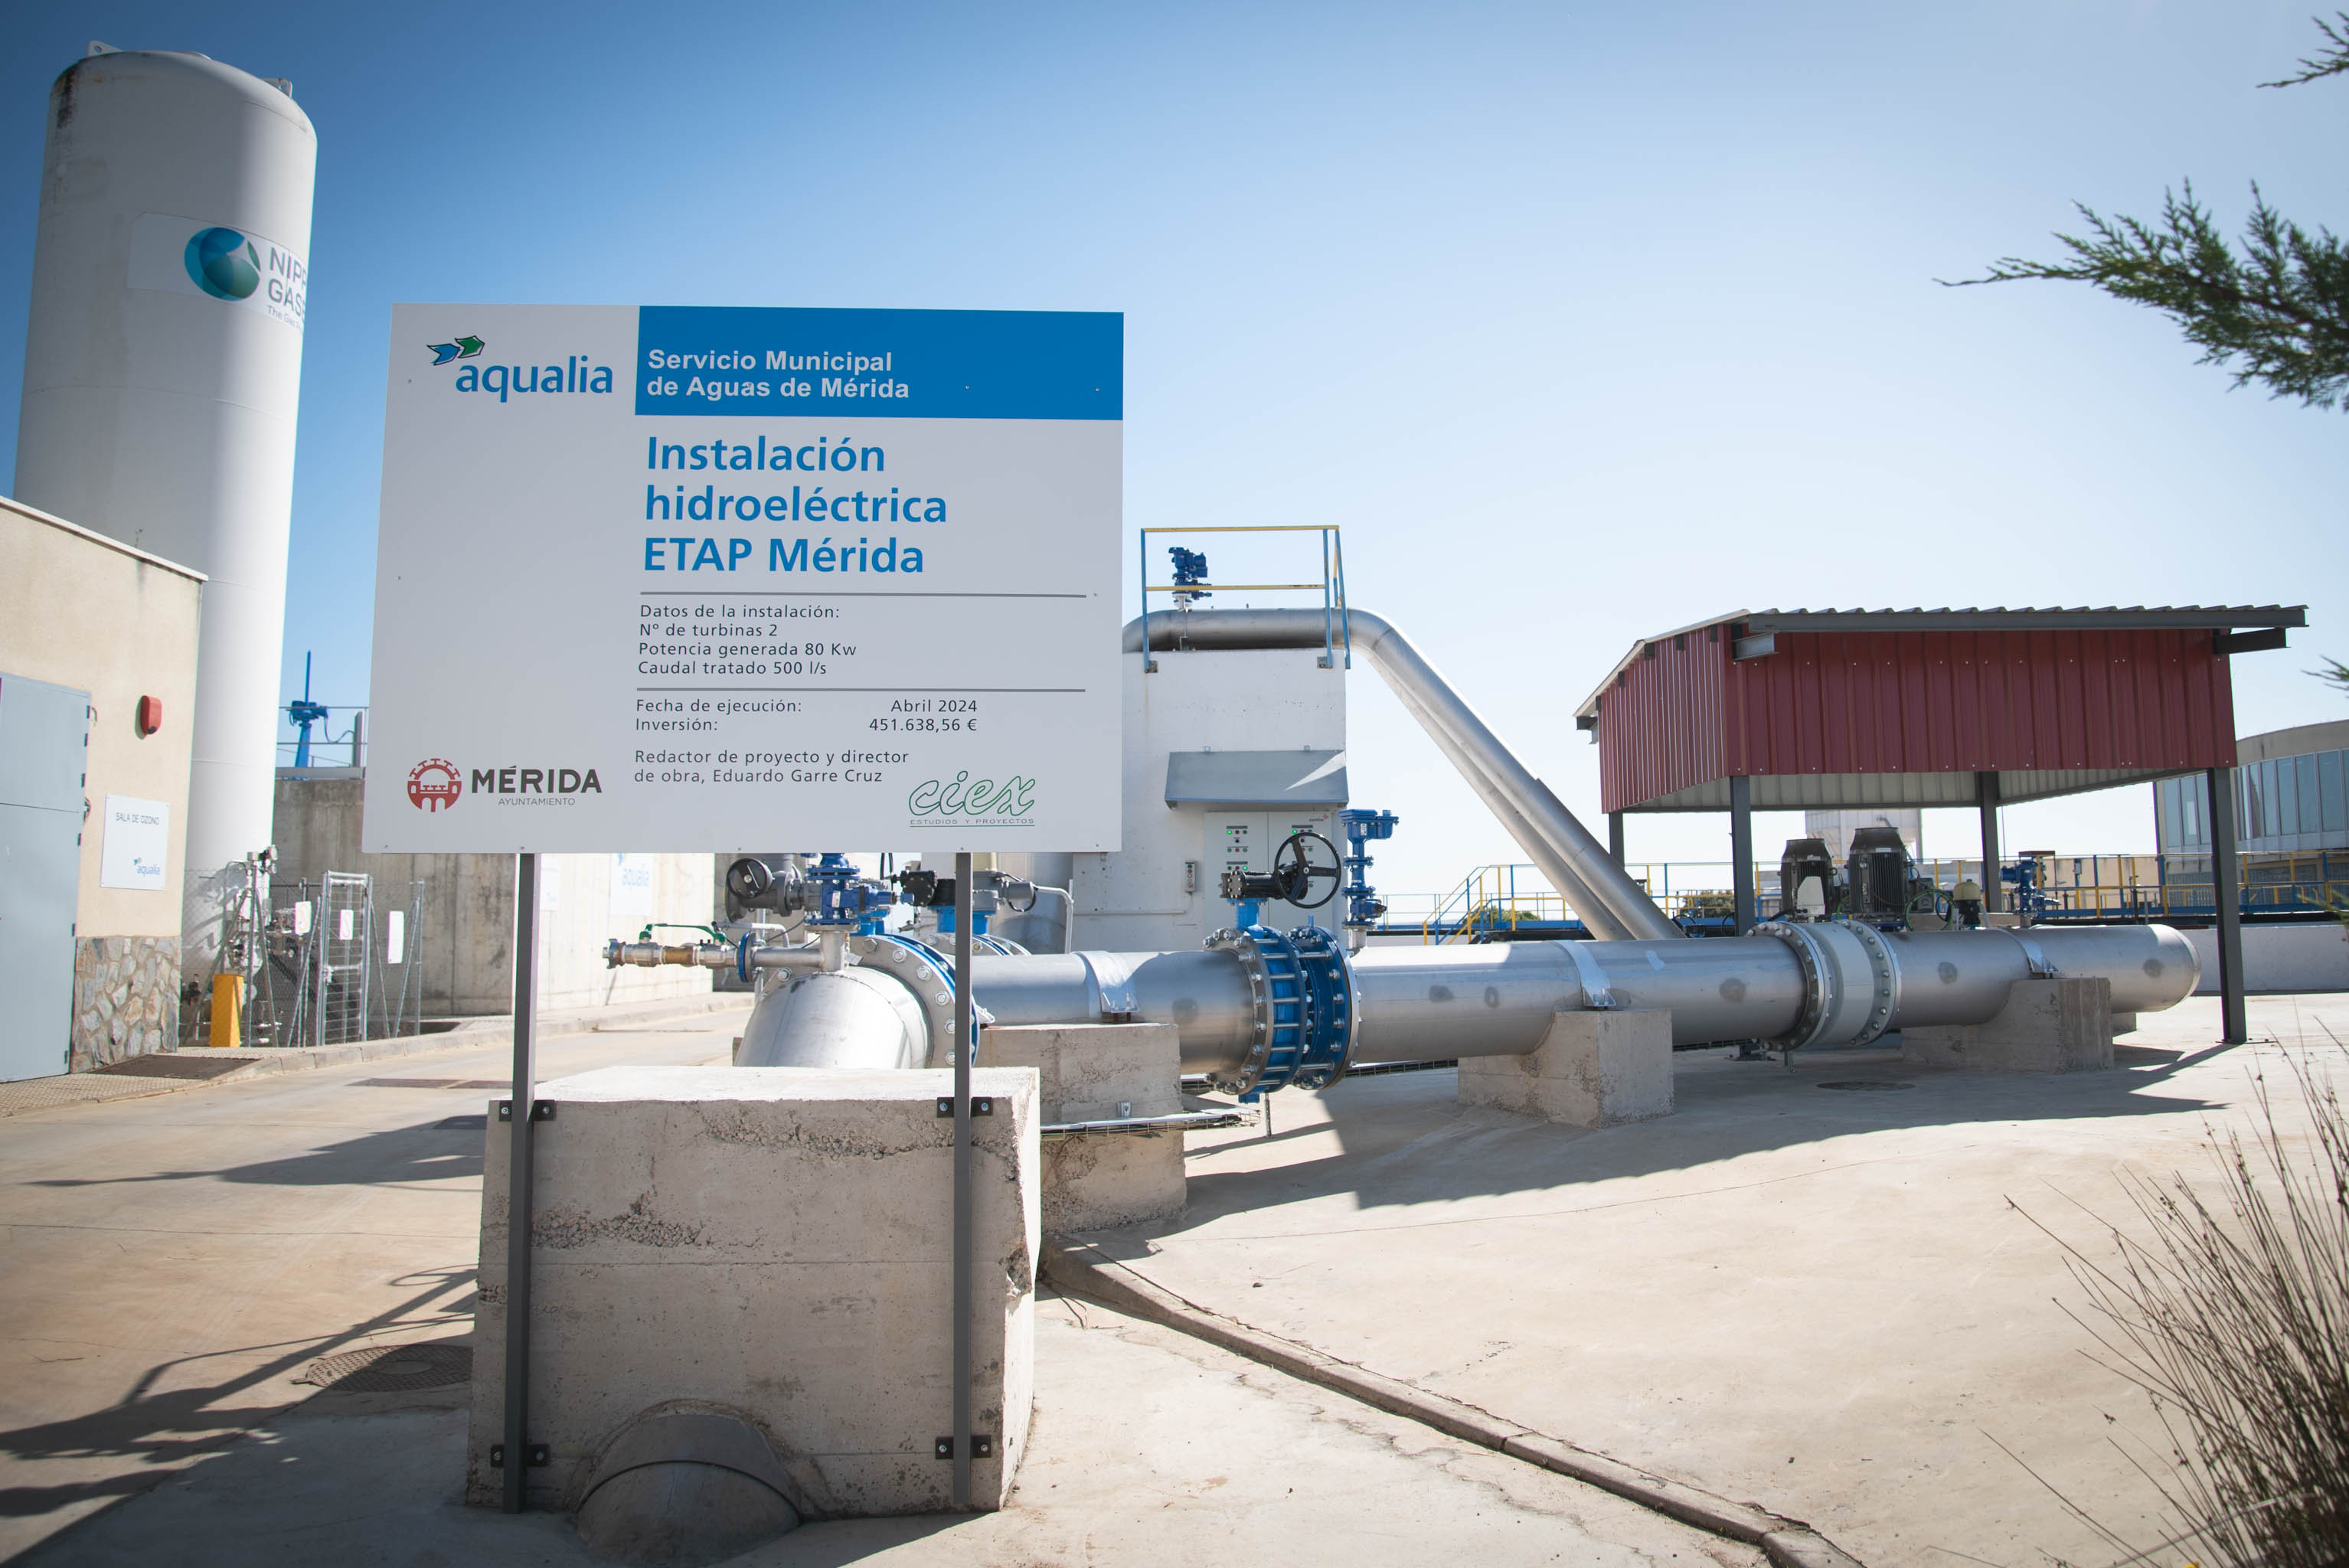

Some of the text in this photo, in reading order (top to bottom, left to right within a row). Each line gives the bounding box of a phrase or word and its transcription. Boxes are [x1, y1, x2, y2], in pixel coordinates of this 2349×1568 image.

[649, 349, 891, 375] Servicio Municipal
[455, 356, 613, 403] aqualia
[647, 375, 909, 401] de Aguas de Mérida
[649, 436, 884, 472] Instalación
[646, 485, 946, 522] hidroeléctrica
[645, 537, 923, 573] ETAP Mérida
[641, 605, 838, 618] Datos de la instalación:
[640, 623, 777, 636] Nº de turbinas 2
[639, 642, 856, 658] Potencia generada 80 Kw
[639, 662, 826, 674] Caudal tratado 500 l/s
[637, 699, 801, 715] Fecha de ejecución:
[891, 699, 977, 712] Abril 2024
[636, 718, 717, 730] Inversión:
[870, 719, 976, 733] 451.638,56 €
[635, 750, 908, 766] Redactor de proyecto y director
[472, 766, 602, 793] MÉRIDA
[635, 769, 881, 784] de obra, Eduardo Garre Cruz
[909, 771, 1035, 816] ciex
[116, 812, 130, 822] SALA
[132, 814, 139, 823] DE
